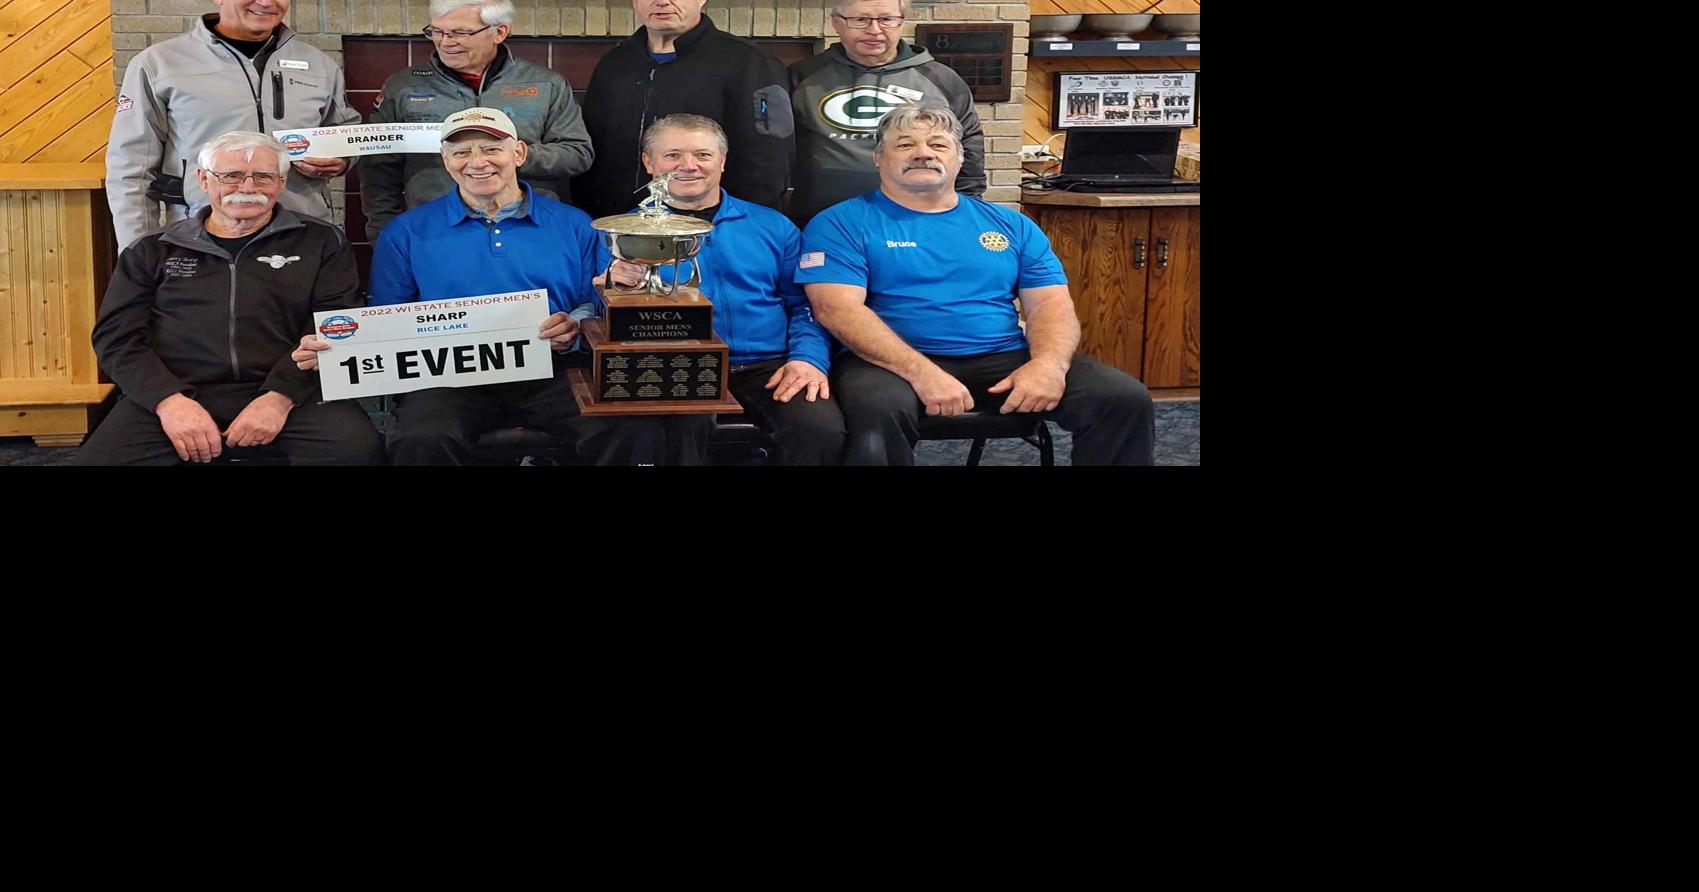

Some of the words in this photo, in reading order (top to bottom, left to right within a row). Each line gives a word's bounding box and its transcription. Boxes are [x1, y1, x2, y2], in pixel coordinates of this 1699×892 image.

[312, 129, 337, 137] 2022
[340, 127, 352, 135] WI
[385, 124, 425, 132] SENIOR
[426, 124, 443, 132] ME
[347, 134, 405, 144] BRANDER
[886, 240, 917, 248] Bruce
[361, 307, 392, 317] 2022
[395, 305, 412, 313] WI
[414, 302, 452, 312] STATE
[454, 297, 501, 308] SENIOR
[503, 292, 541, 302] MEN'S
[416, 311, 467, 323] SHARP
[638, 311, 683, 320] WSCA
[417, 325, 440, 333] RICE
[443, 323, 469, 331] LAKE
[632, 330, 689, 338] CHAMPIONS
[340, 354, 385, 385] 1st
[396, 339, 531, 380] EVENT
